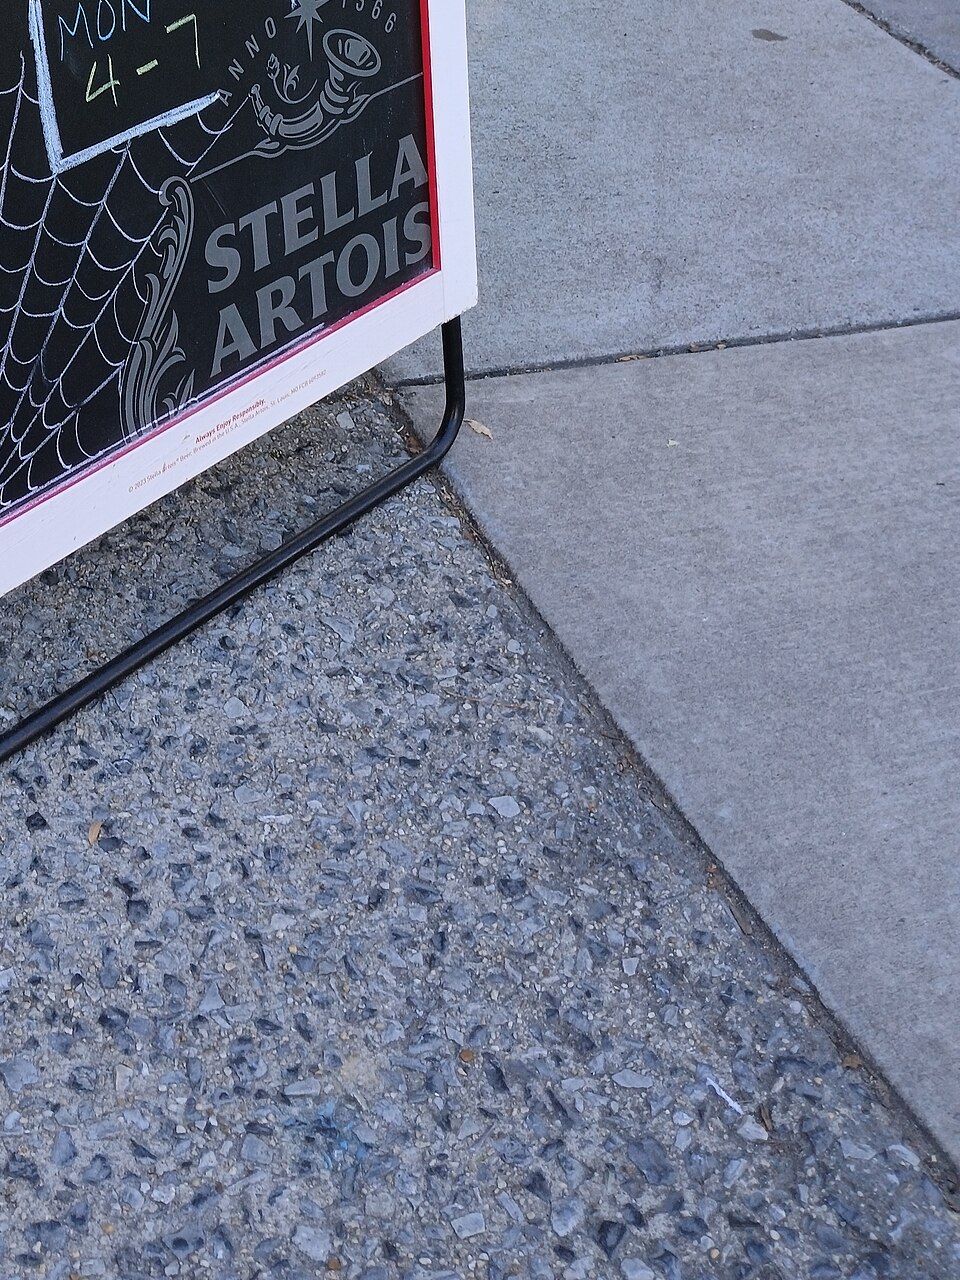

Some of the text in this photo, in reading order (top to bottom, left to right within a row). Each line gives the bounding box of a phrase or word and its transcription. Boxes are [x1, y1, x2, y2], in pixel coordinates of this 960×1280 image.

[84, 53, 121, 108] 4
[164, 13, 201, 70] 7
[218, 16, 277, 107] ANNO
[204, 133, 429, 294] STELLA
[210, 201, 432, 378] ARTOIS
[195, 428, 216, 444] Always
[216, 419, 231, 432] Enjoy
